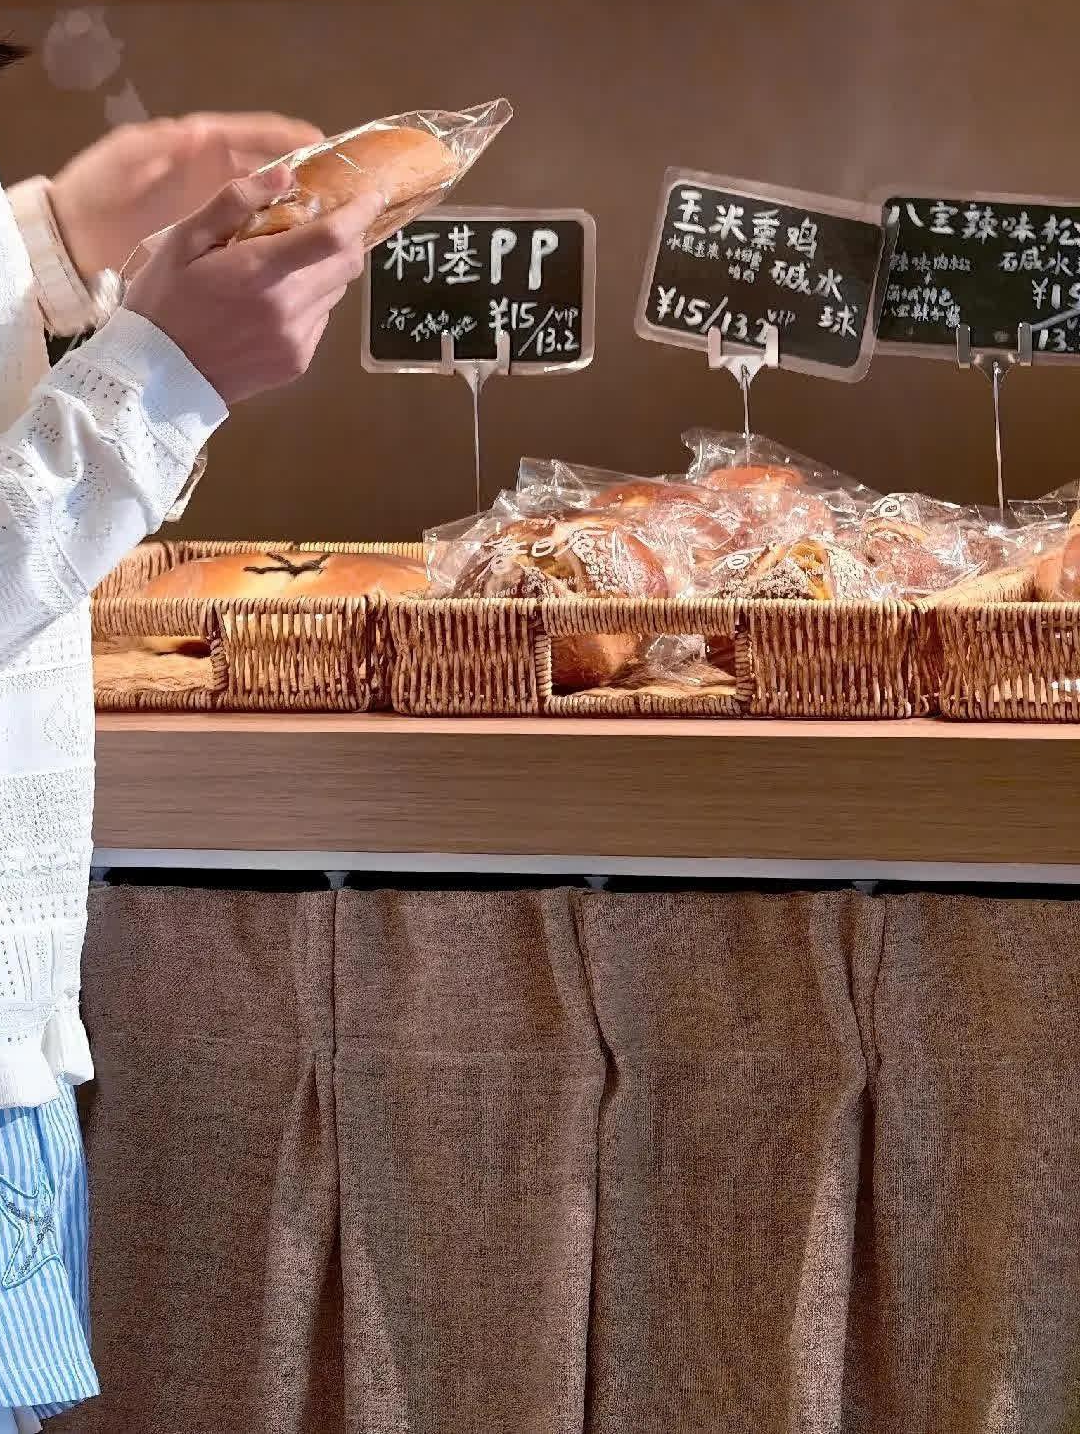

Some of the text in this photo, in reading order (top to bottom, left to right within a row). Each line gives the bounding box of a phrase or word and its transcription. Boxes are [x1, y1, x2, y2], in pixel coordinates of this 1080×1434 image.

[383, 224, 560, 290] 柯基PP
[673, 190, 818, 259] 玉米熏鸡
[998, 245, 1080, 277] 碱水
